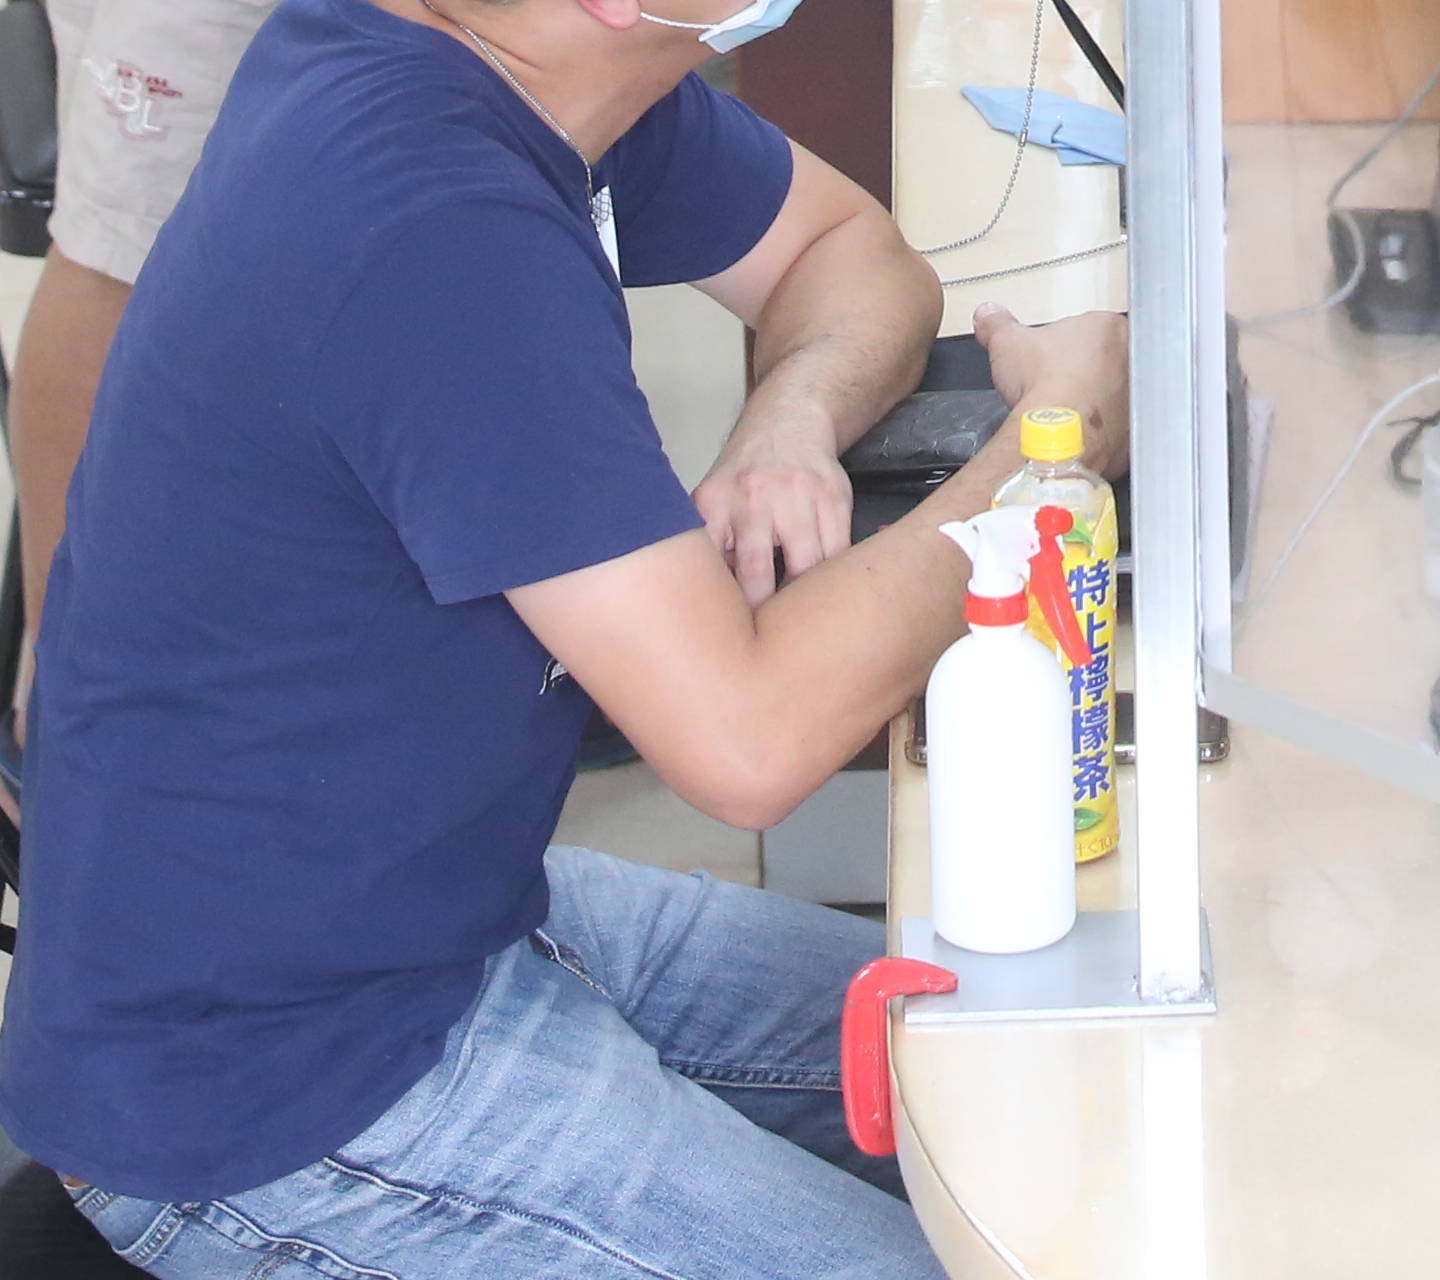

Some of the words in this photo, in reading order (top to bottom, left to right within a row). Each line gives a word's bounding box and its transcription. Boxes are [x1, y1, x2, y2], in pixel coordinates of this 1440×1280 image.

[1067, 559, 1110, 801] 特上檸檬茶
